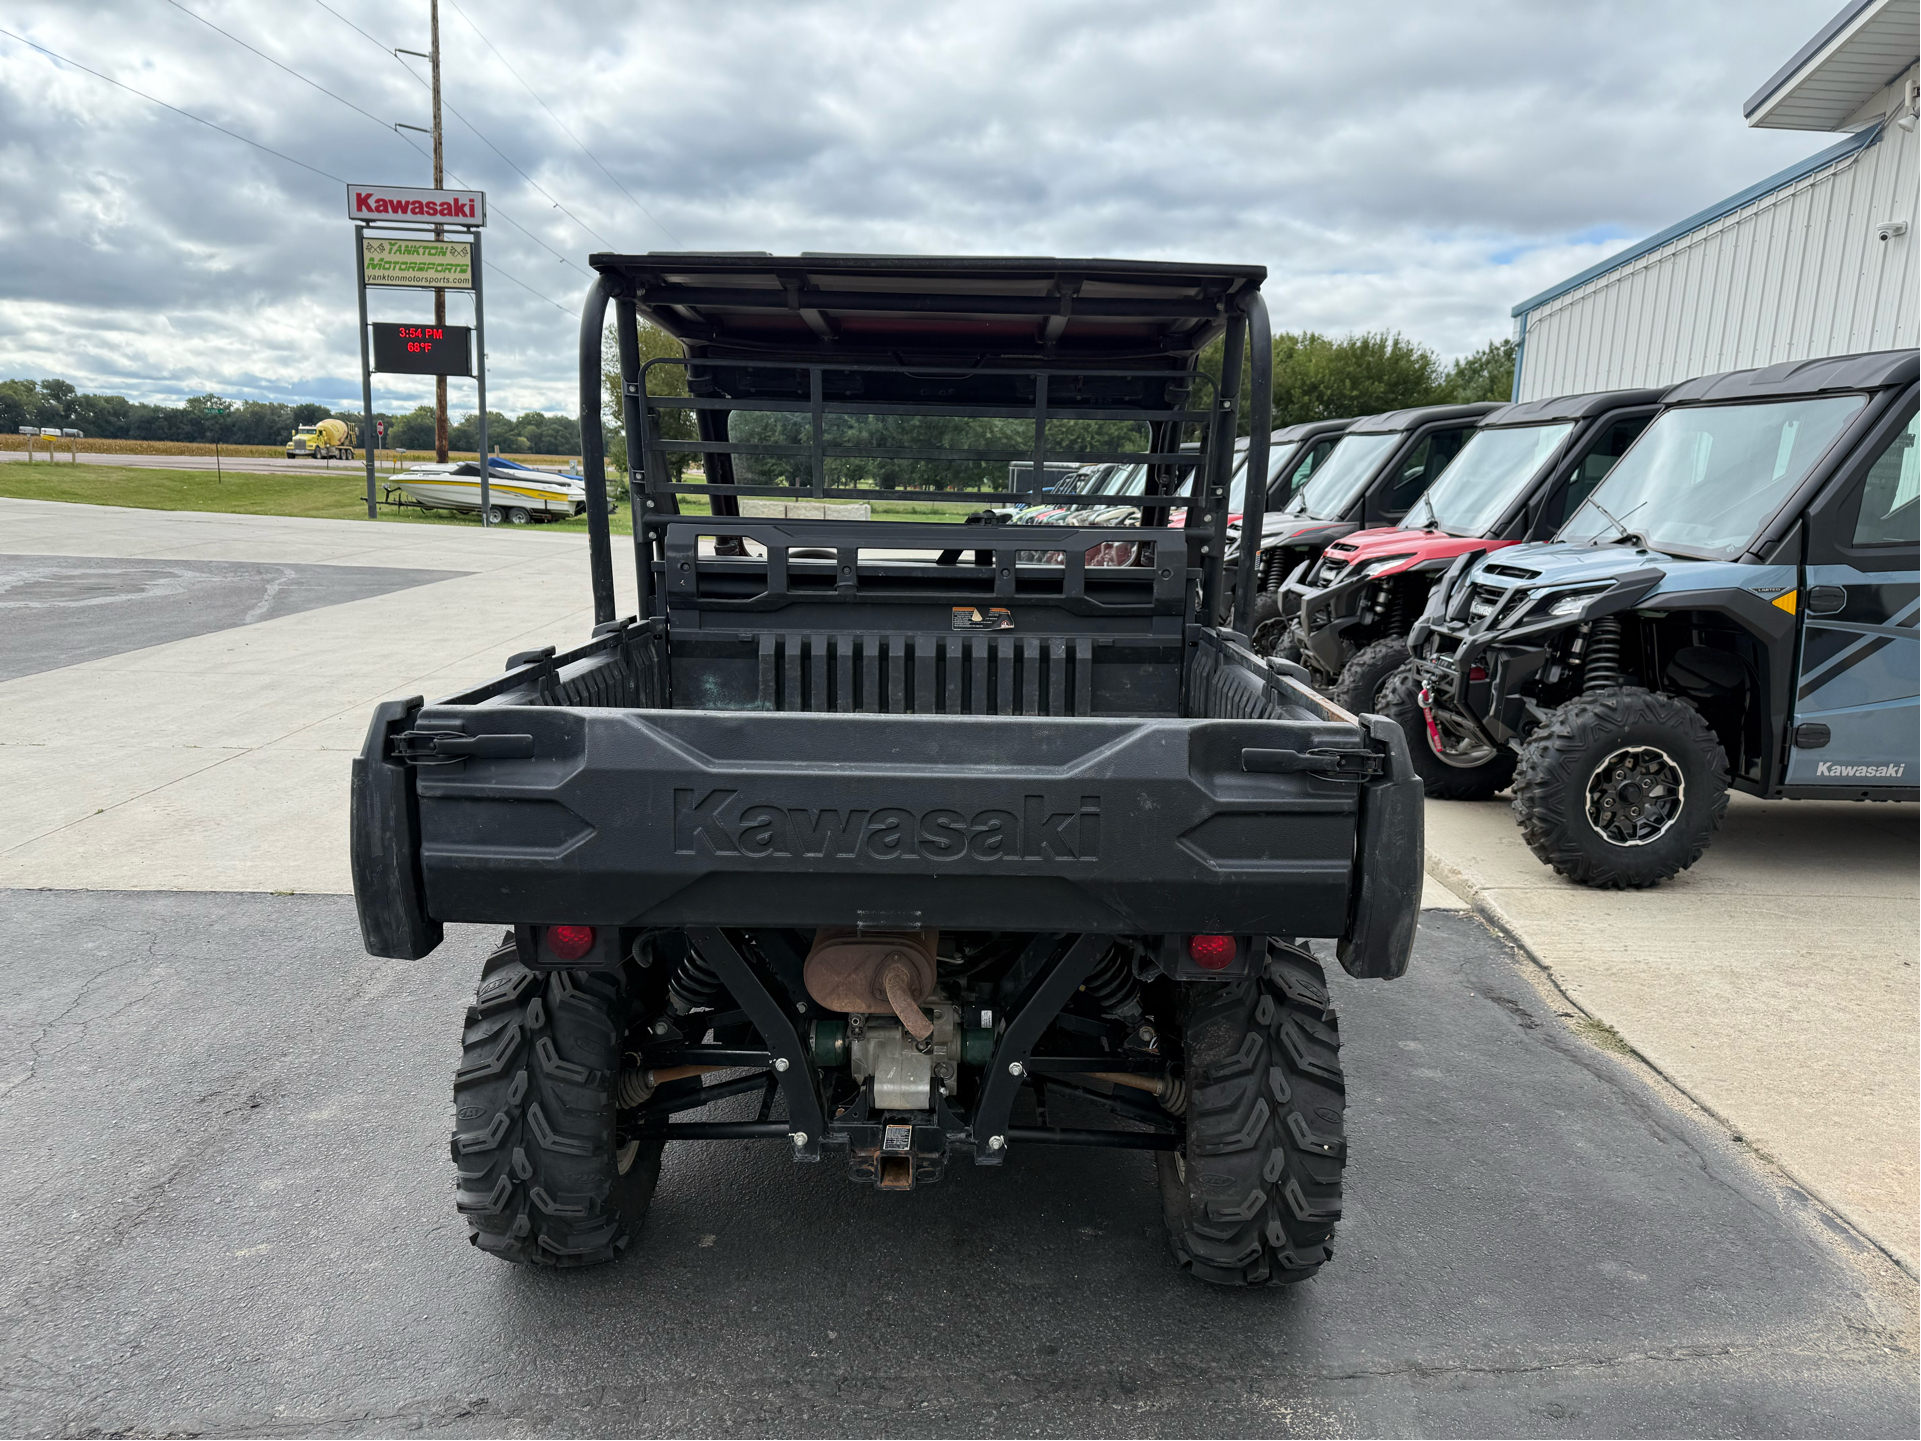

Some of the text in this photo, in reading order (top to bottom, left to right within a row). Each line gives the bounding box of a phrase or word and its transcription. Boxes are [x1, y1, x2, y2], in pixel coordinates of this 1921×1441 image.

[355, 192, 475, 218] Kawasaki
[387, 241, 448, 257] YANKTON
[366, 257, 469, 274] MOTORSPORTS
[366, 273, 470, 285] yanktonmotorsports.com
[399, 327, 443, 339] 3:54 PM
[407, 342, 432, 353] 68°F
[1816, 762, 1906, 777] Kawasaki
[673, 787, 1101, 861] Kawasaki
